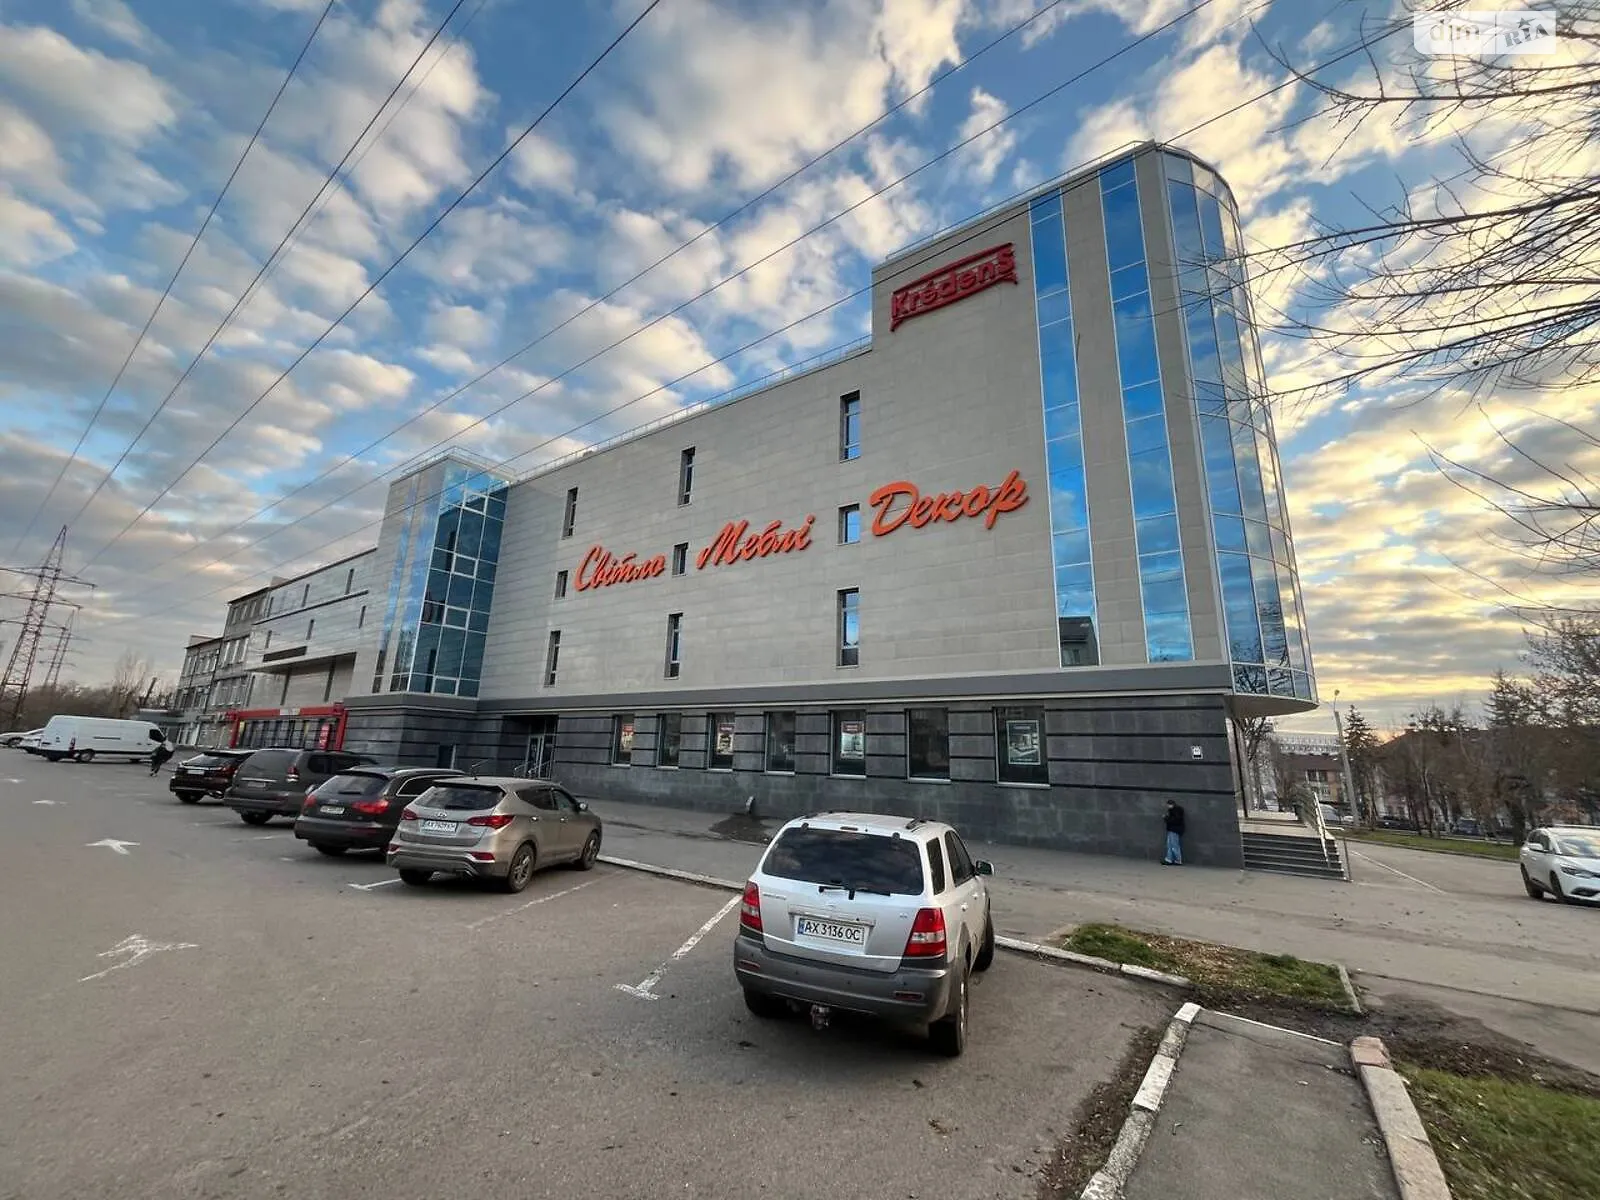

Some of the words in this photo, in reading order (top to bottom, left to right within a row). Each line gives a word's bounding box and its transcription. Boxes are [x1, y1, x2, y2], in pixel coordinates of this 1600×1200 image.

[575, 544, 666, 592] Світло
[696, 514, 816, 570] Меблі
[869, 469, 1029, 537] Декор
[820, 923, 844, 939] 3136
